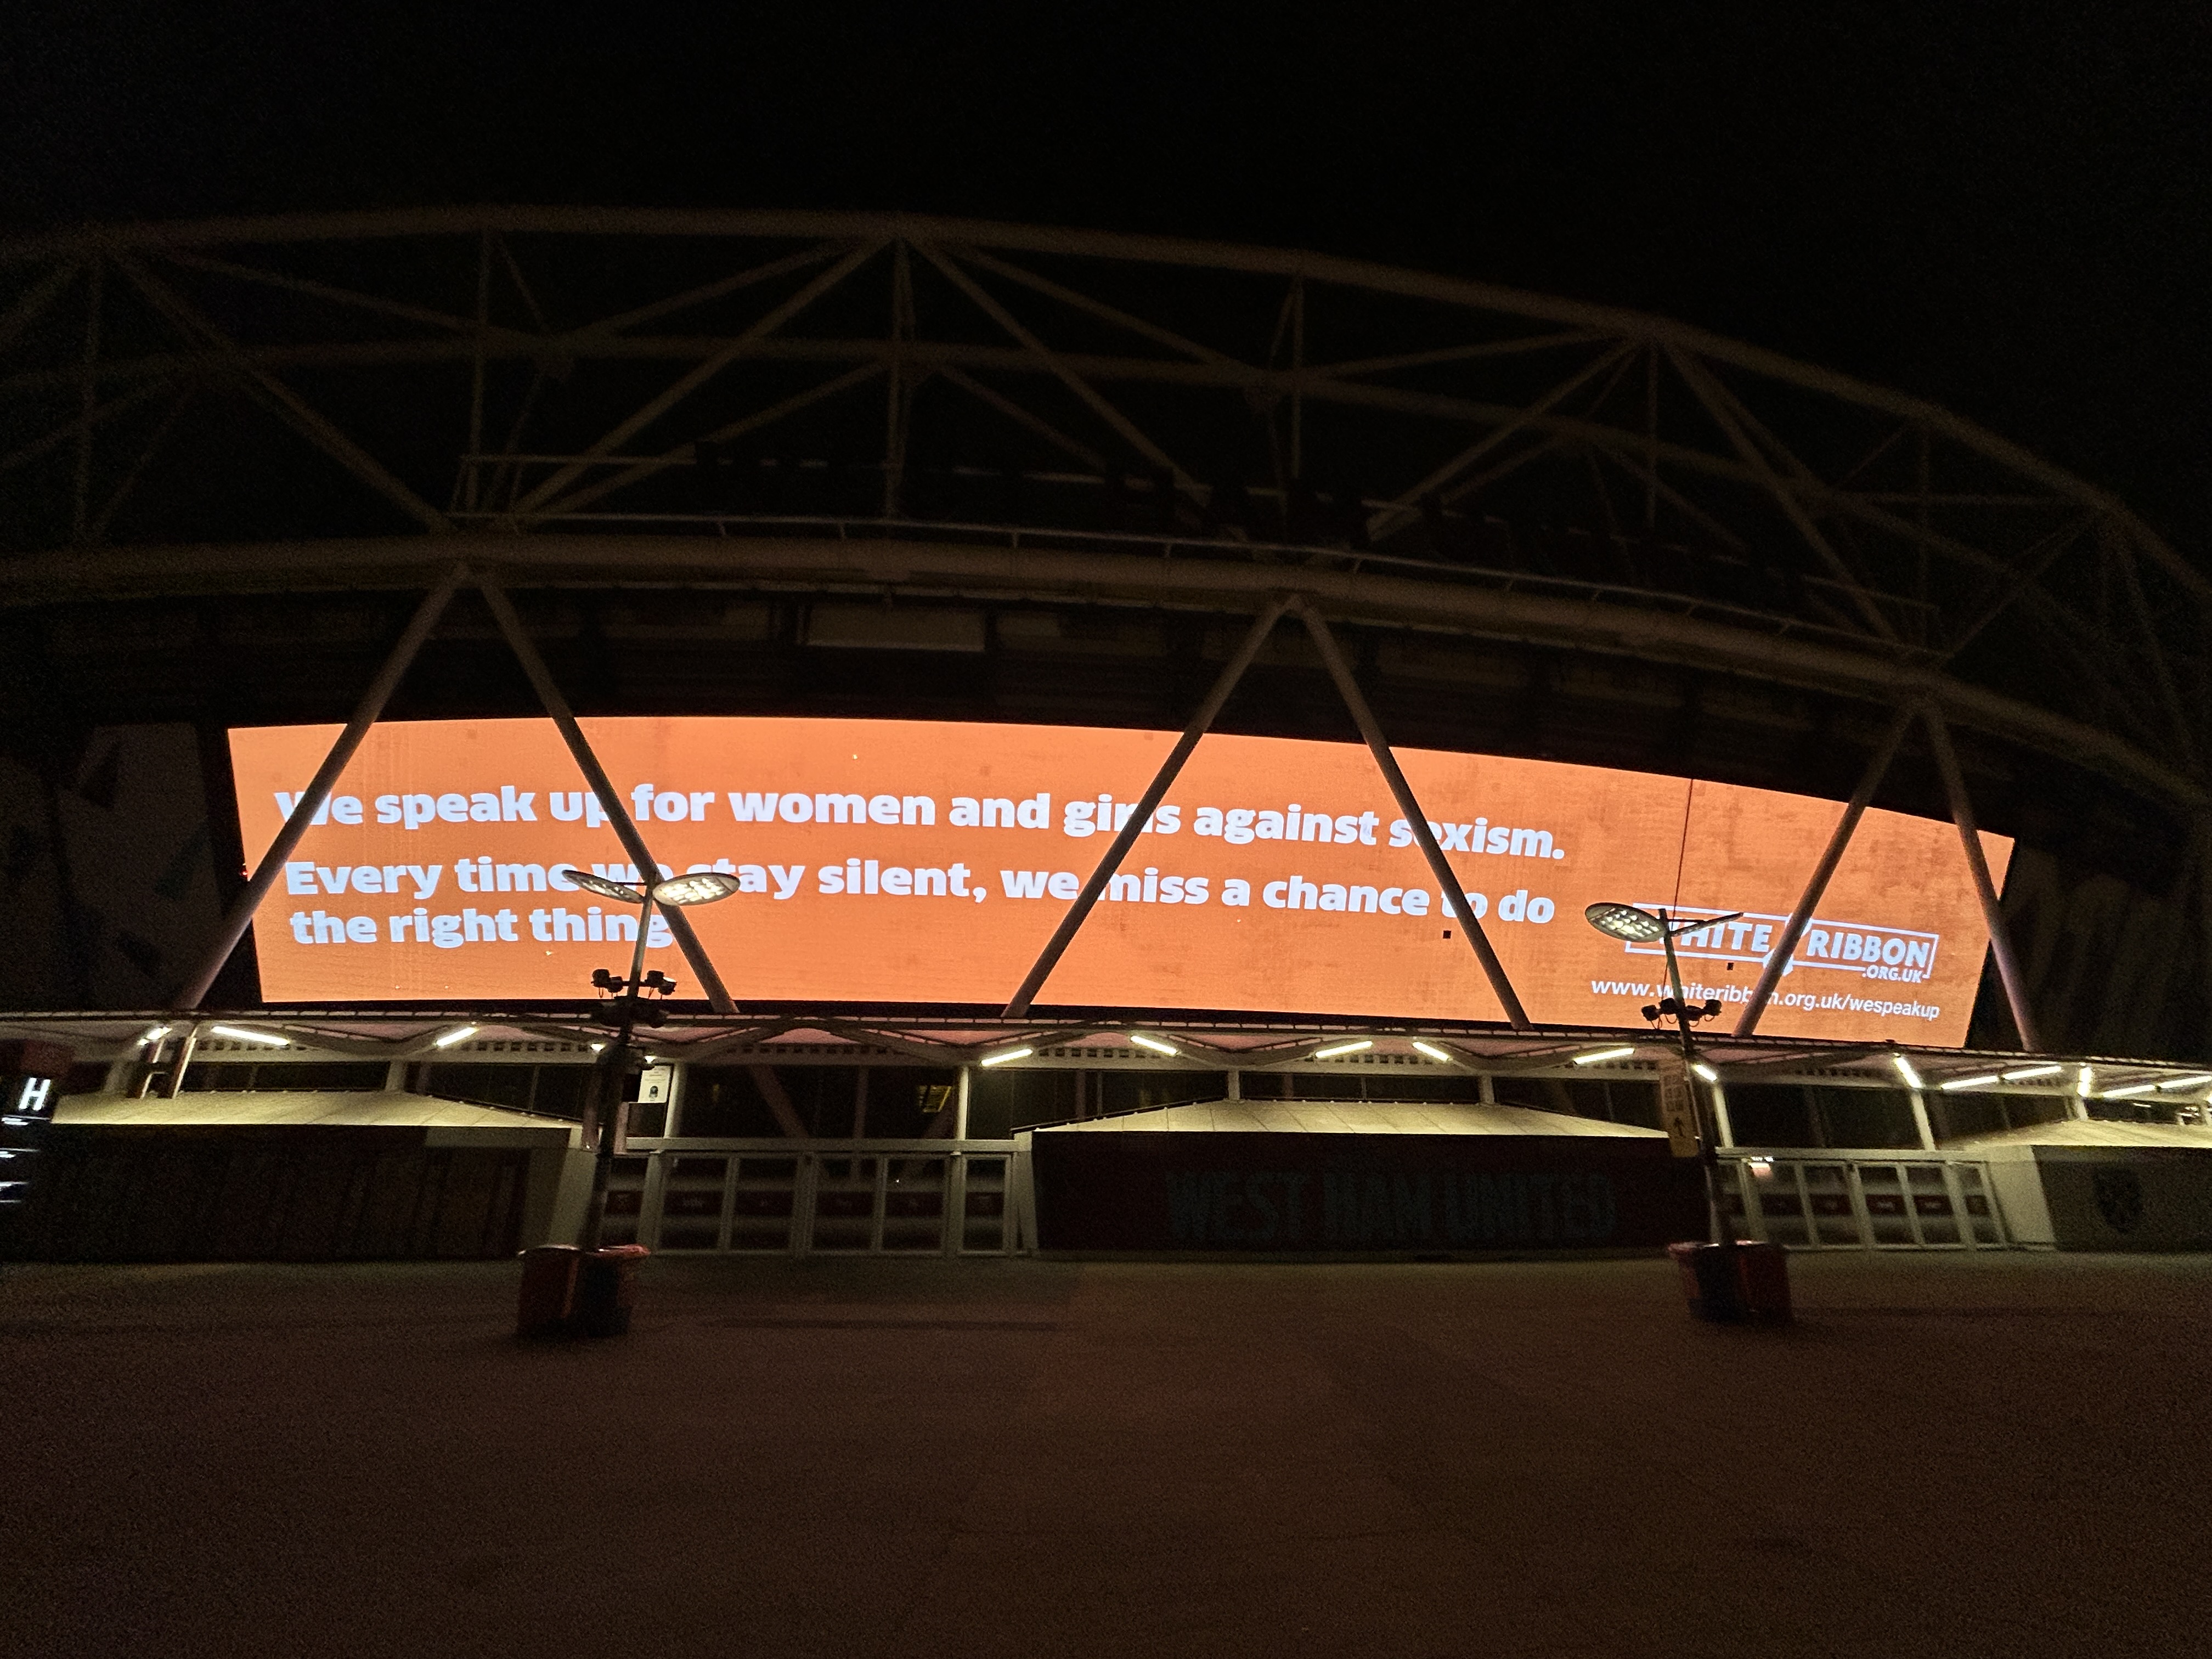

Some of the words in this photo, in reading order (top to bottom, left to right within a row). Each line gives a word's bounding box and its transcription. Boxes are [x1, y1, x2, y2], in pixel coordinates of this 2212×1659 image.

[274, 792, 363, 825] We
[375, 785, 537, 830] speak
[631, 783, 715, 821] for
[728, 792, 935, 826] women
[949, 793, 1051, 829] and
[1063, 793, 1181, 837] girs
[1193, 803, 1380, 845] against
[284, 861, 443, 899] Every
[454, 856, 580, 892] time
[591, 863, 674, 891] w
[818, 857, 987, 902] silent,
[1000, 870, 1080, 900] we
[1097, 867, 1209, 905] miss
[1221, 878, 1250, 906] a
[1262, 875, 1430, 916] chance
[1498, 889, 1555, 924] do
[290, 910, 377, 944] the
[388, 907, 519, 949] right
[528, 906, 673, 949] thing
[1657, 915, 1773, 952] HITE
[1806, 929, 1931, 968] RIBBON
[19, 1077, 51, 1111] H
[1165, 1170, 1310, 1241] WEST
[1323, 1172, 1433, 1240] HAM
[1445, 1172, 1617, 1241] UNITED
